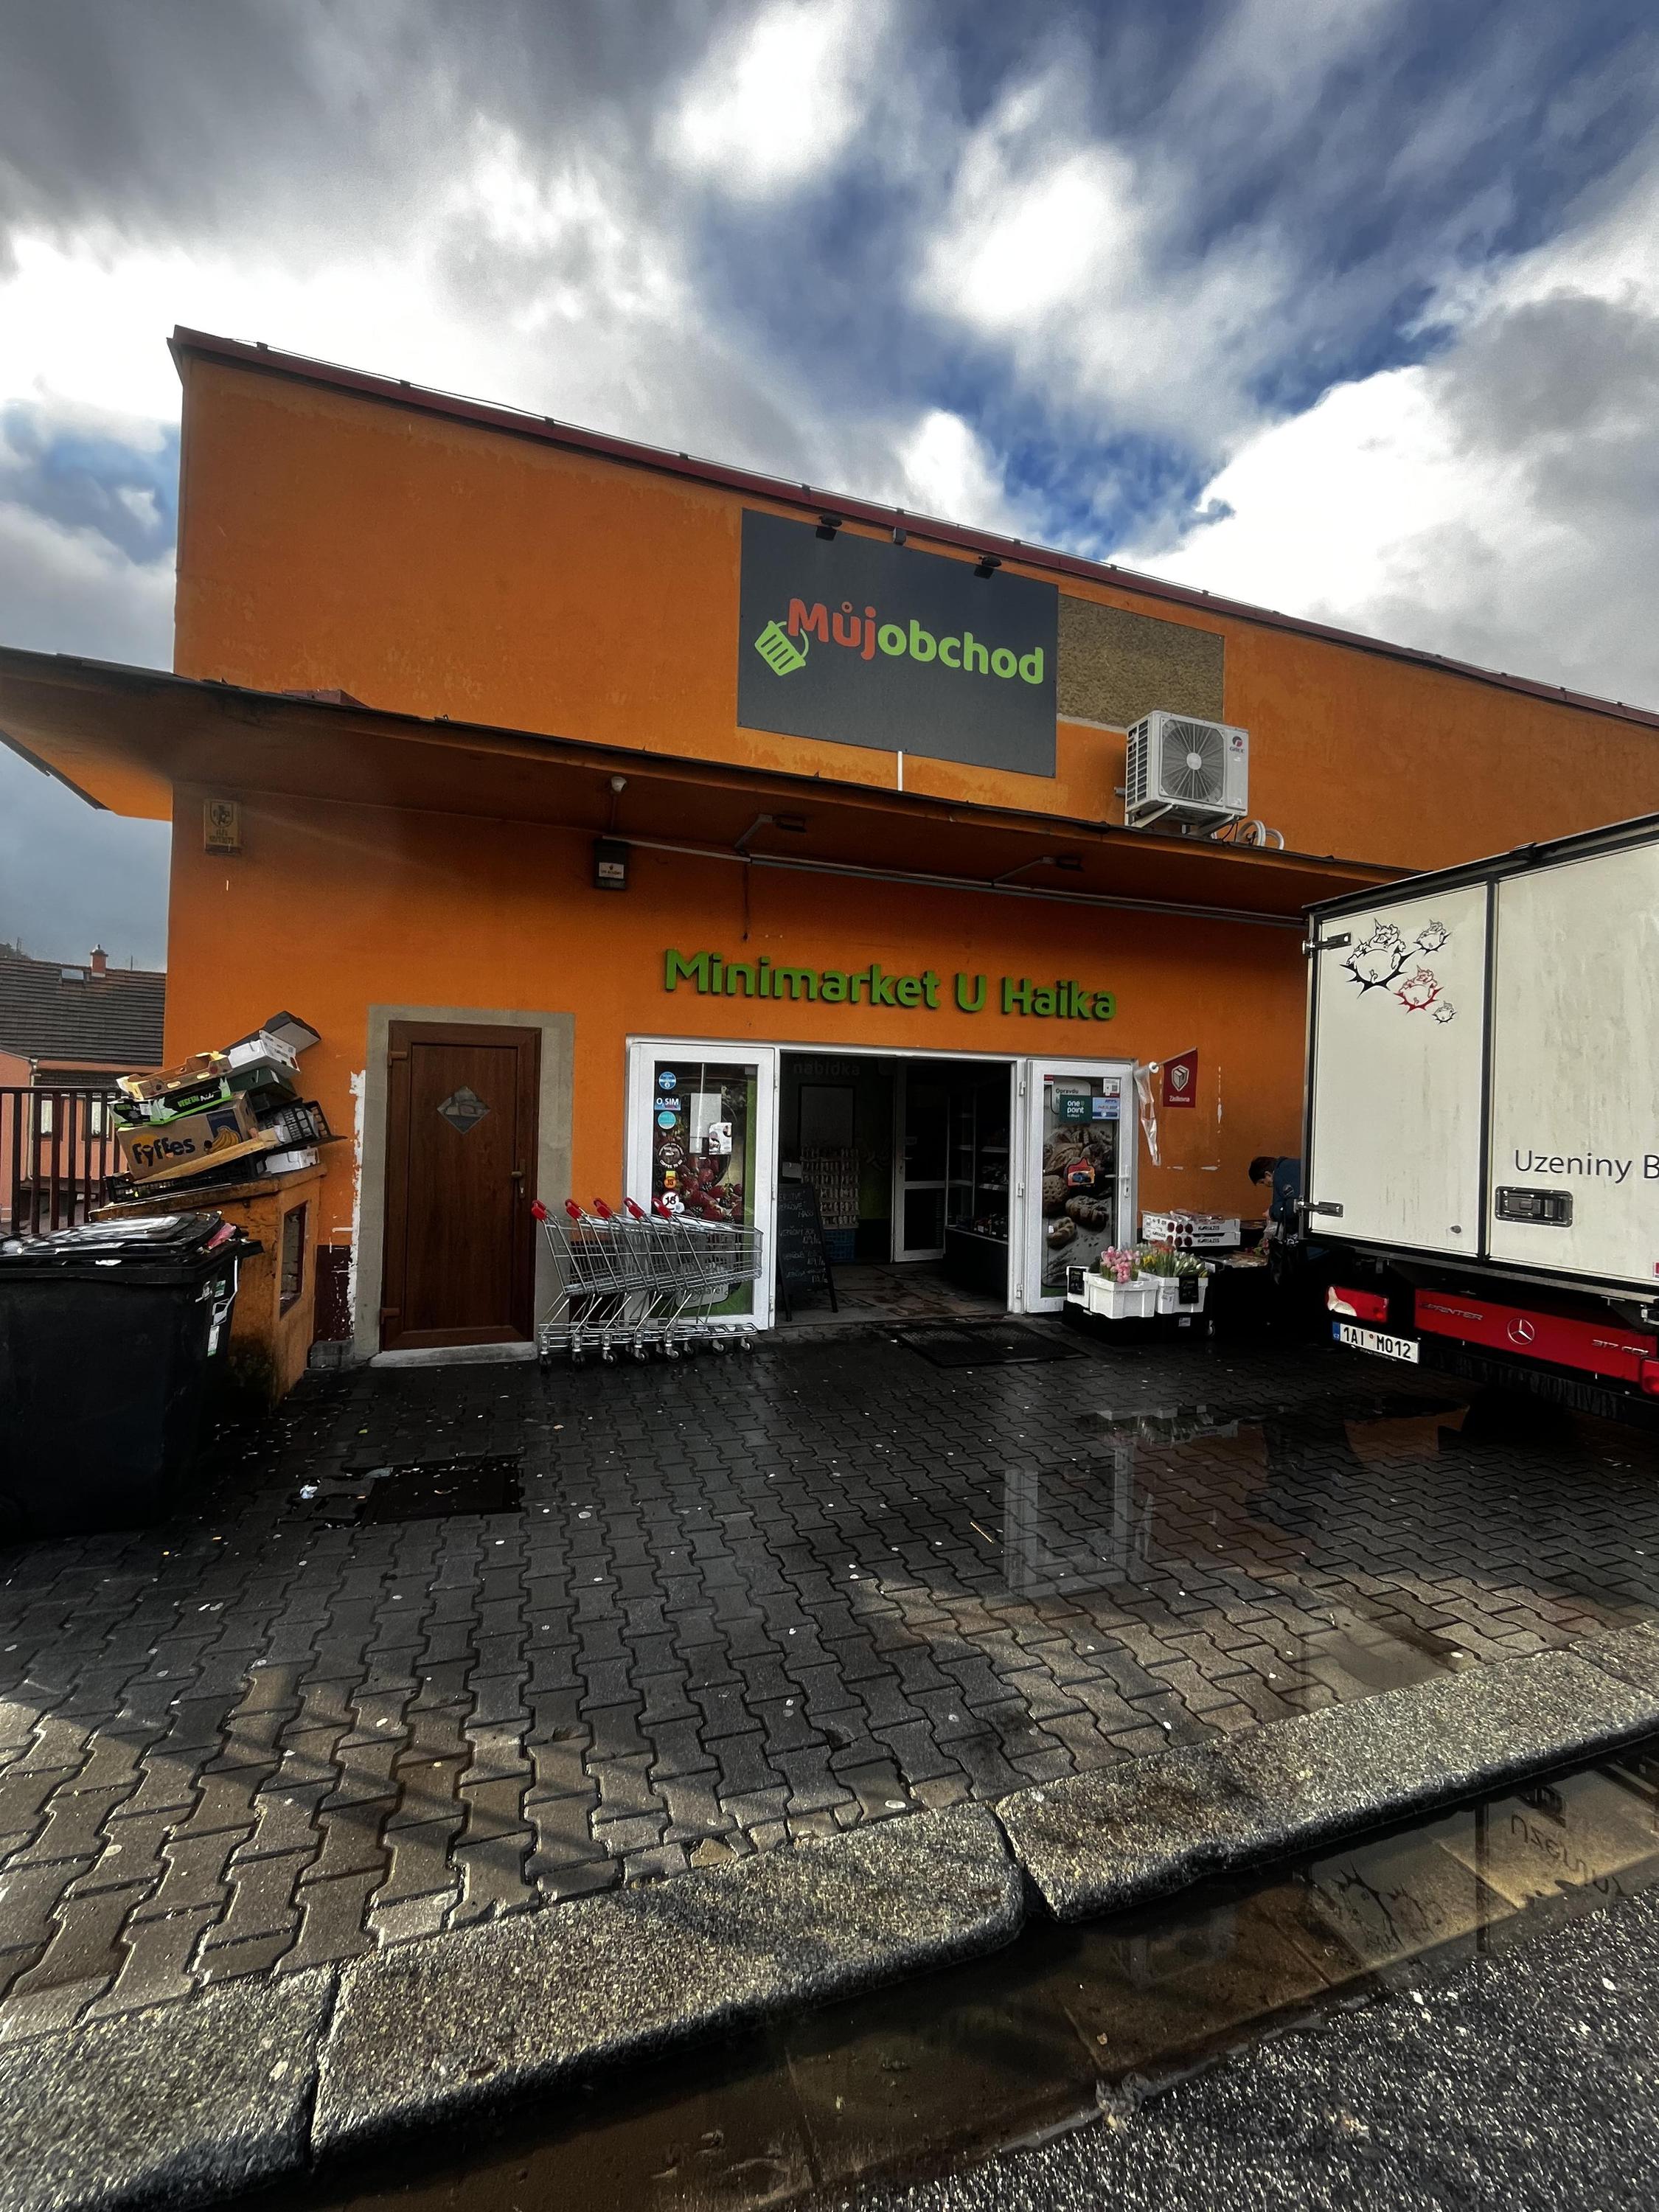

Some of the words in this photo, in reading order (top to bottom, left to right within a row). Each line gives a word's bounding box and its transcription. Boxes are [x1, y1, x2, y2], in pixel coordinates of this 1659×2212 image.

[665, 948, 941, 1009] Minimarket
[956, 973, 987, 1012] U
[1001, 975, 1116, 1020] Haika
[665, 1098, 679, 1106] SIM
[1514, 1149, 1632, 1184] Uzeniny
[1343, 1326, 1363, 1346] 1AI
